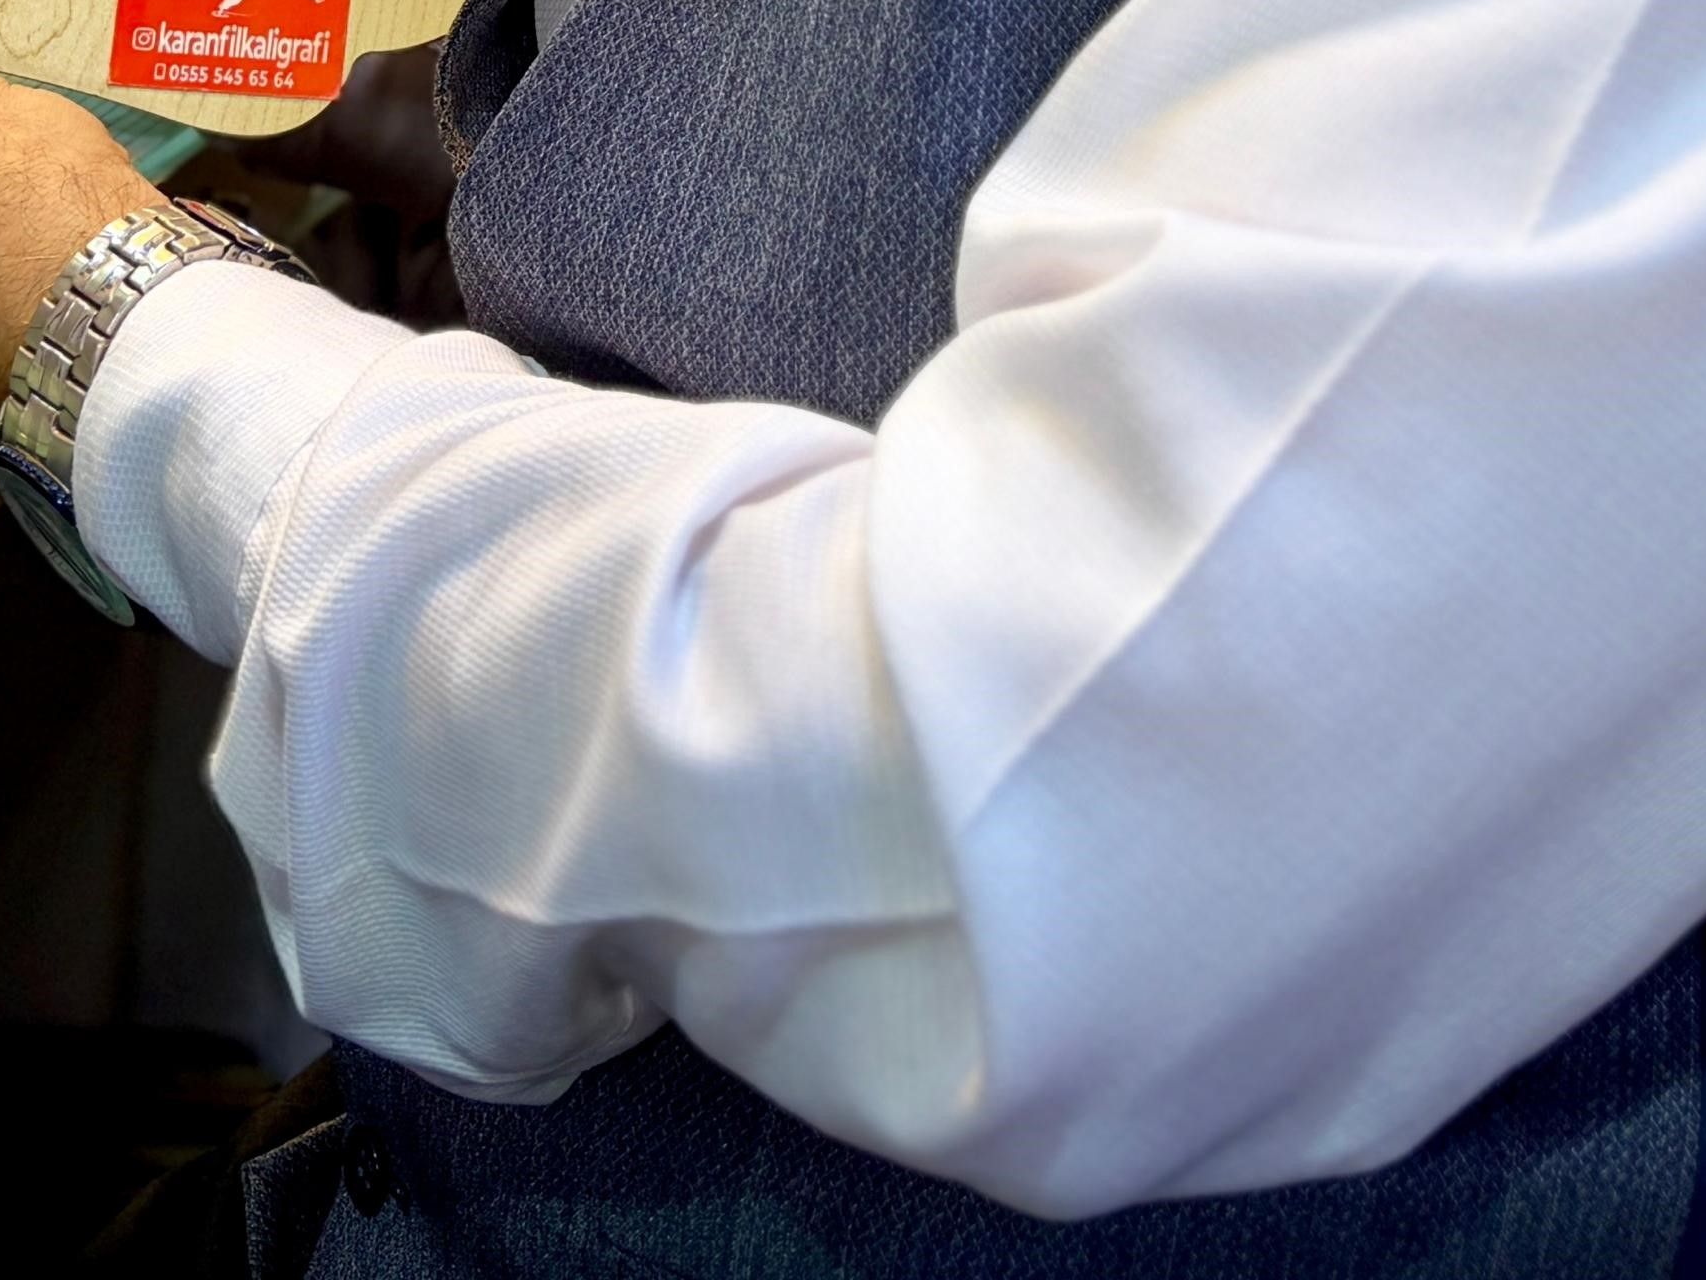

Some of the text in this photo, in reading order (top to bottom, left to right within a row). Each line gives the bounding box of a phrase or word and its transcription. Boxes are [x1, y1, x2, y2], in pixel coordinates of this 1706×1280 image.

[157, 20, 331, 69] karanfilkaligrafi
[168, 64, 295, 89] 0555 545 65 64
